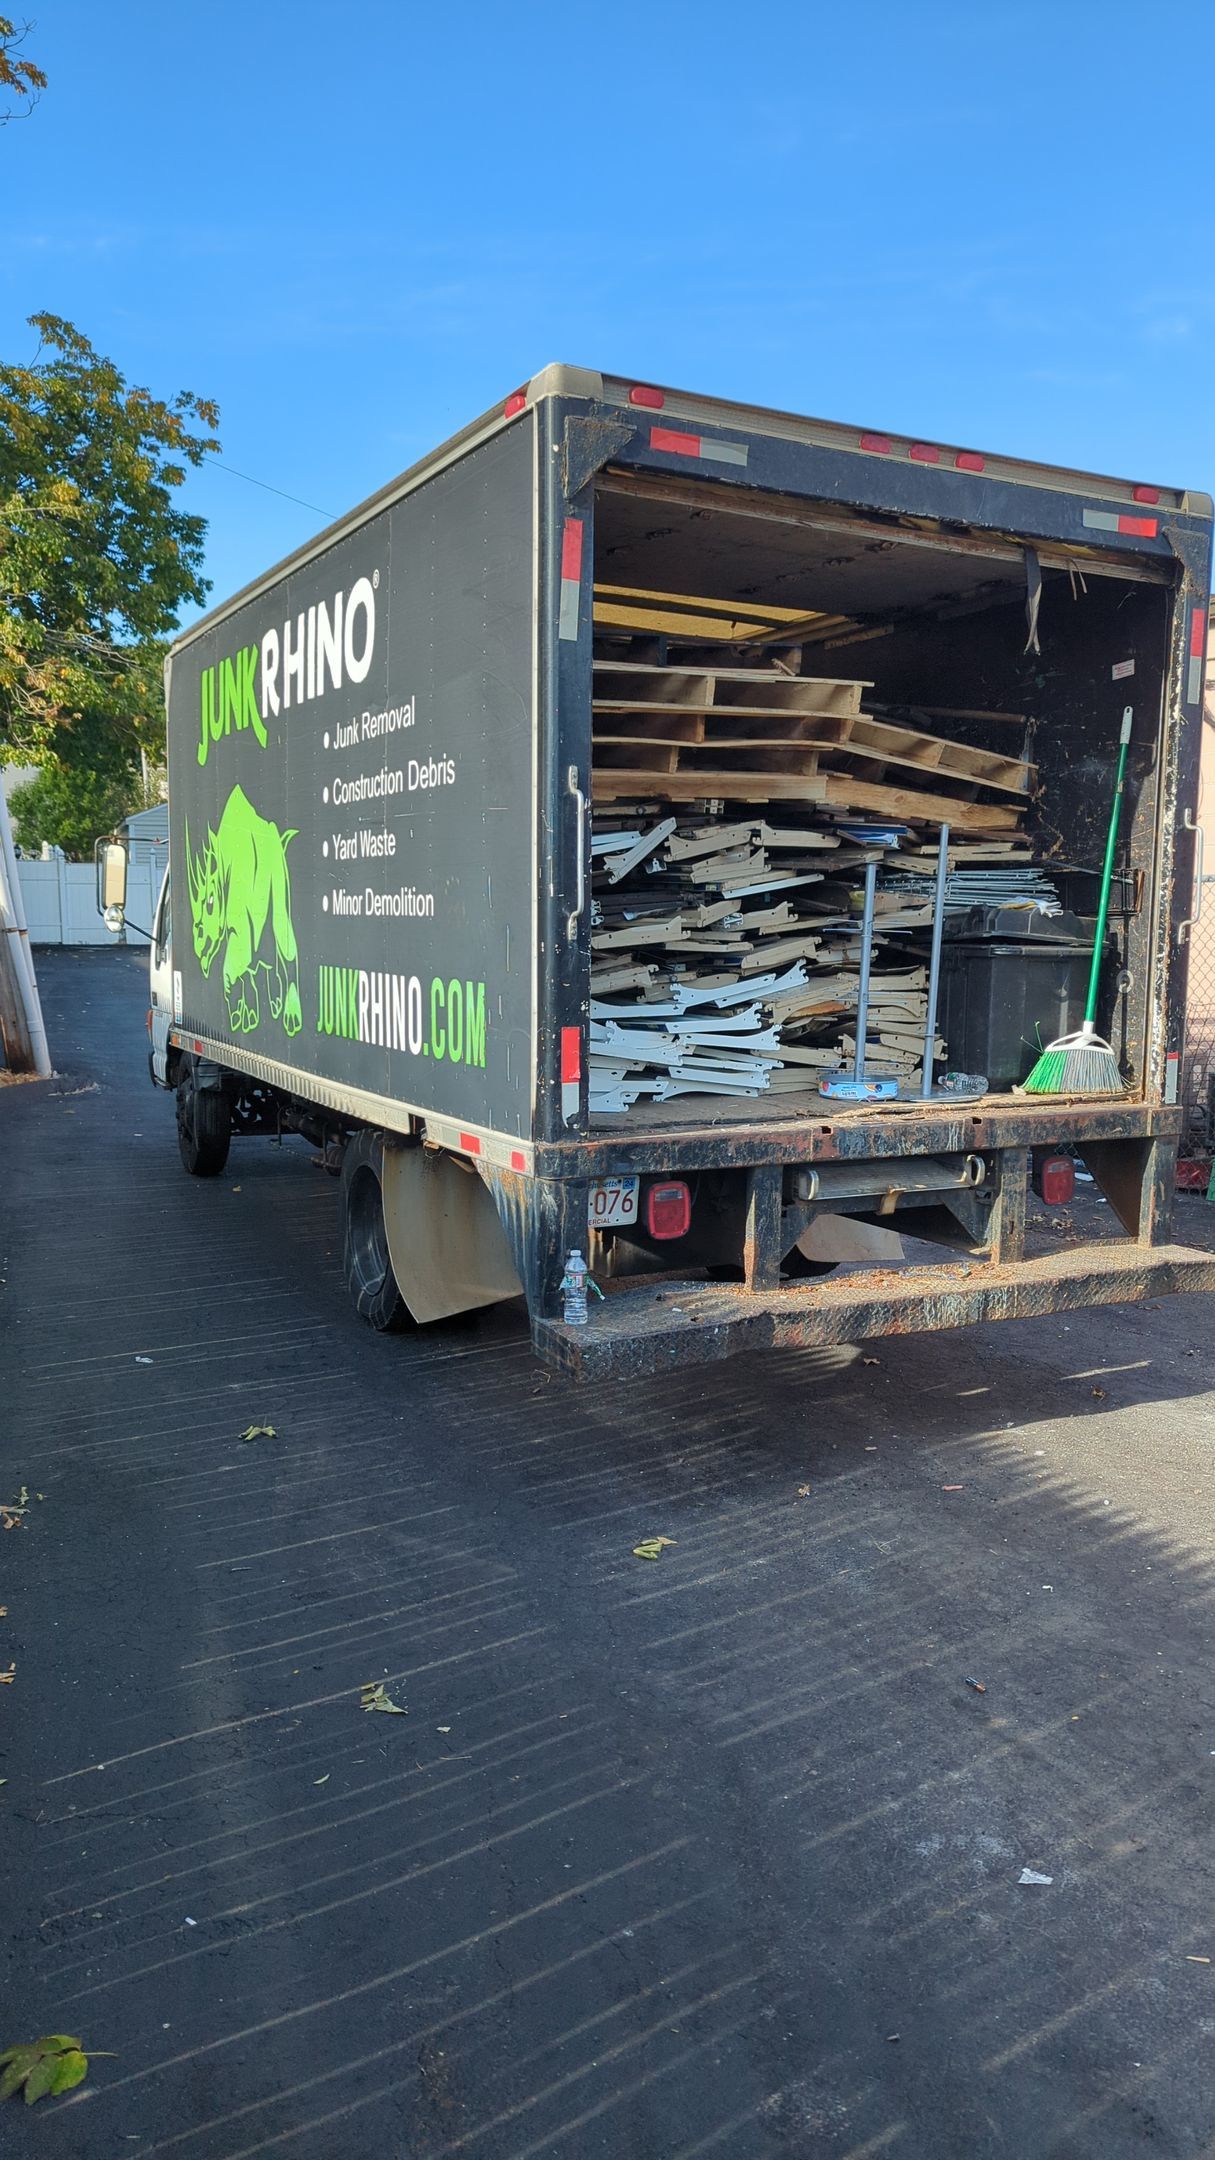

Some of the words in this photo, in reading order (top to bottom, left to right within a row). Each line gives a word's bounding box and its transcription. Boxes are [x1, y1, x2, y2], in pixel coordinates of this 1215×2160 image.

[333, 717, 360, 750] Junk
[361, 694, 415, 741] Removal
[332, 766, 404, 806] Construction
[407, 752, 456, 791] Debris
[332, 831, 358, 861] Yard
[359, 828, 396, 858] Waste
[332, 888, 363, 916] Minor
[365, 886, 434, 917] Demolition
[316, 965, 487, 1068] JUNKRHINO.COM
[595, 1189, 634, 1215] 076
